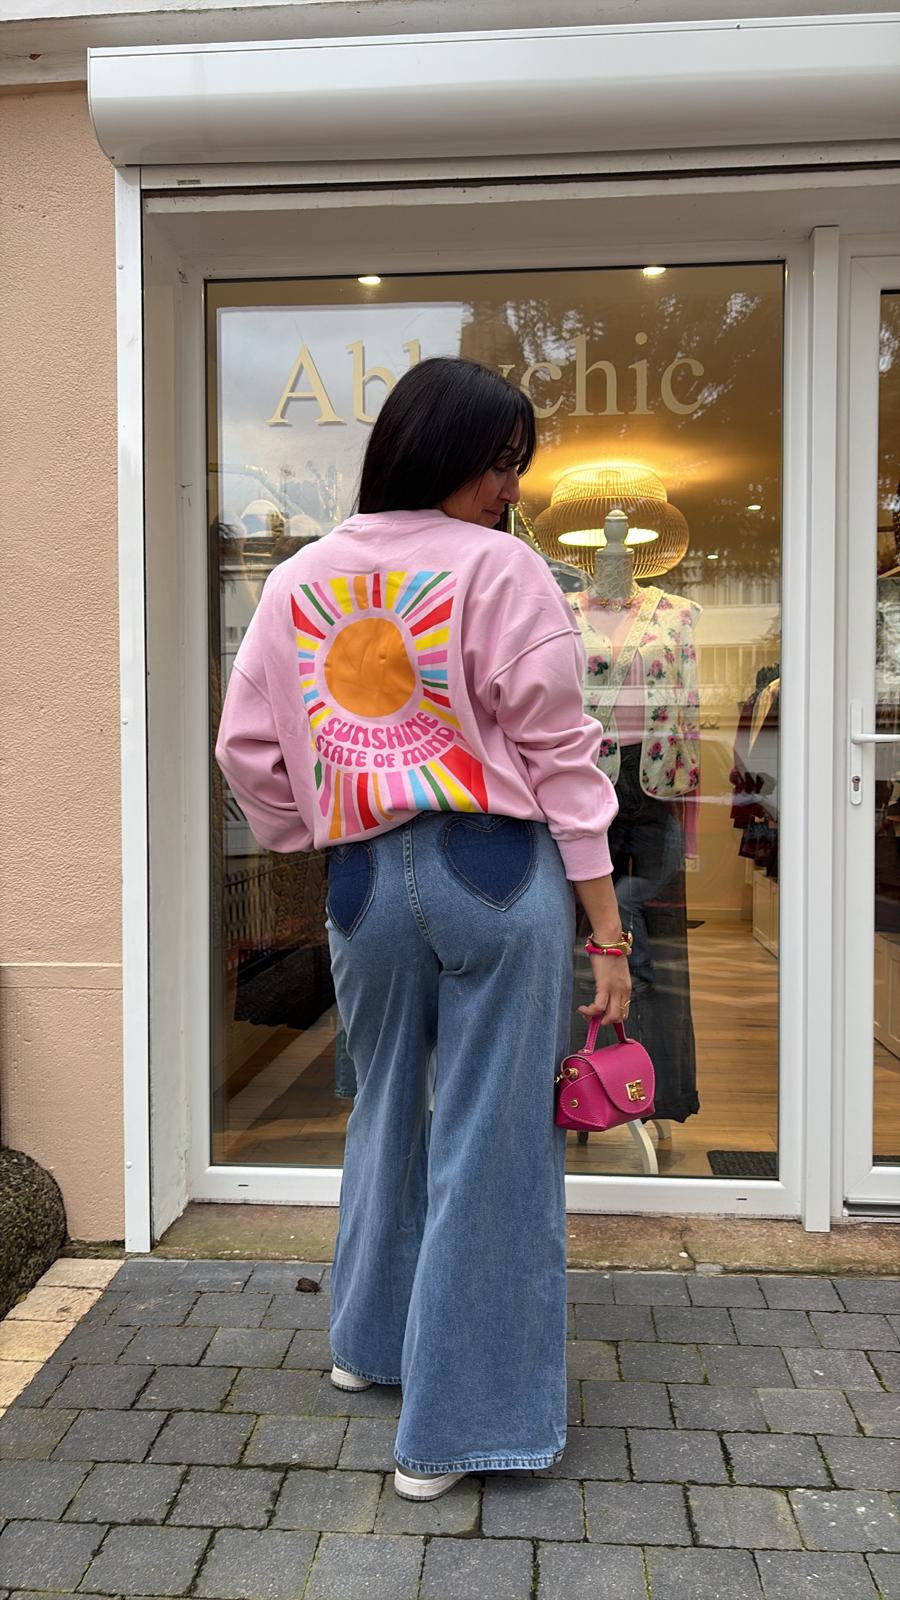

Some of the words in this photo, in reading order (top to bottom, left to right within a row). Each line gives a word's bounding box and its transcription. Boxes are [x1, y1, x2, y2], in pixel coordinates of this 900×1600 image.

[264, 331, 706, 426] Abchic
[315, 734, 367, 767] STATE
[373, 753, 396, 768] OF
[402, 726, 456, 766] MIND
[321, 711, 439, 750] SUNSHINE
